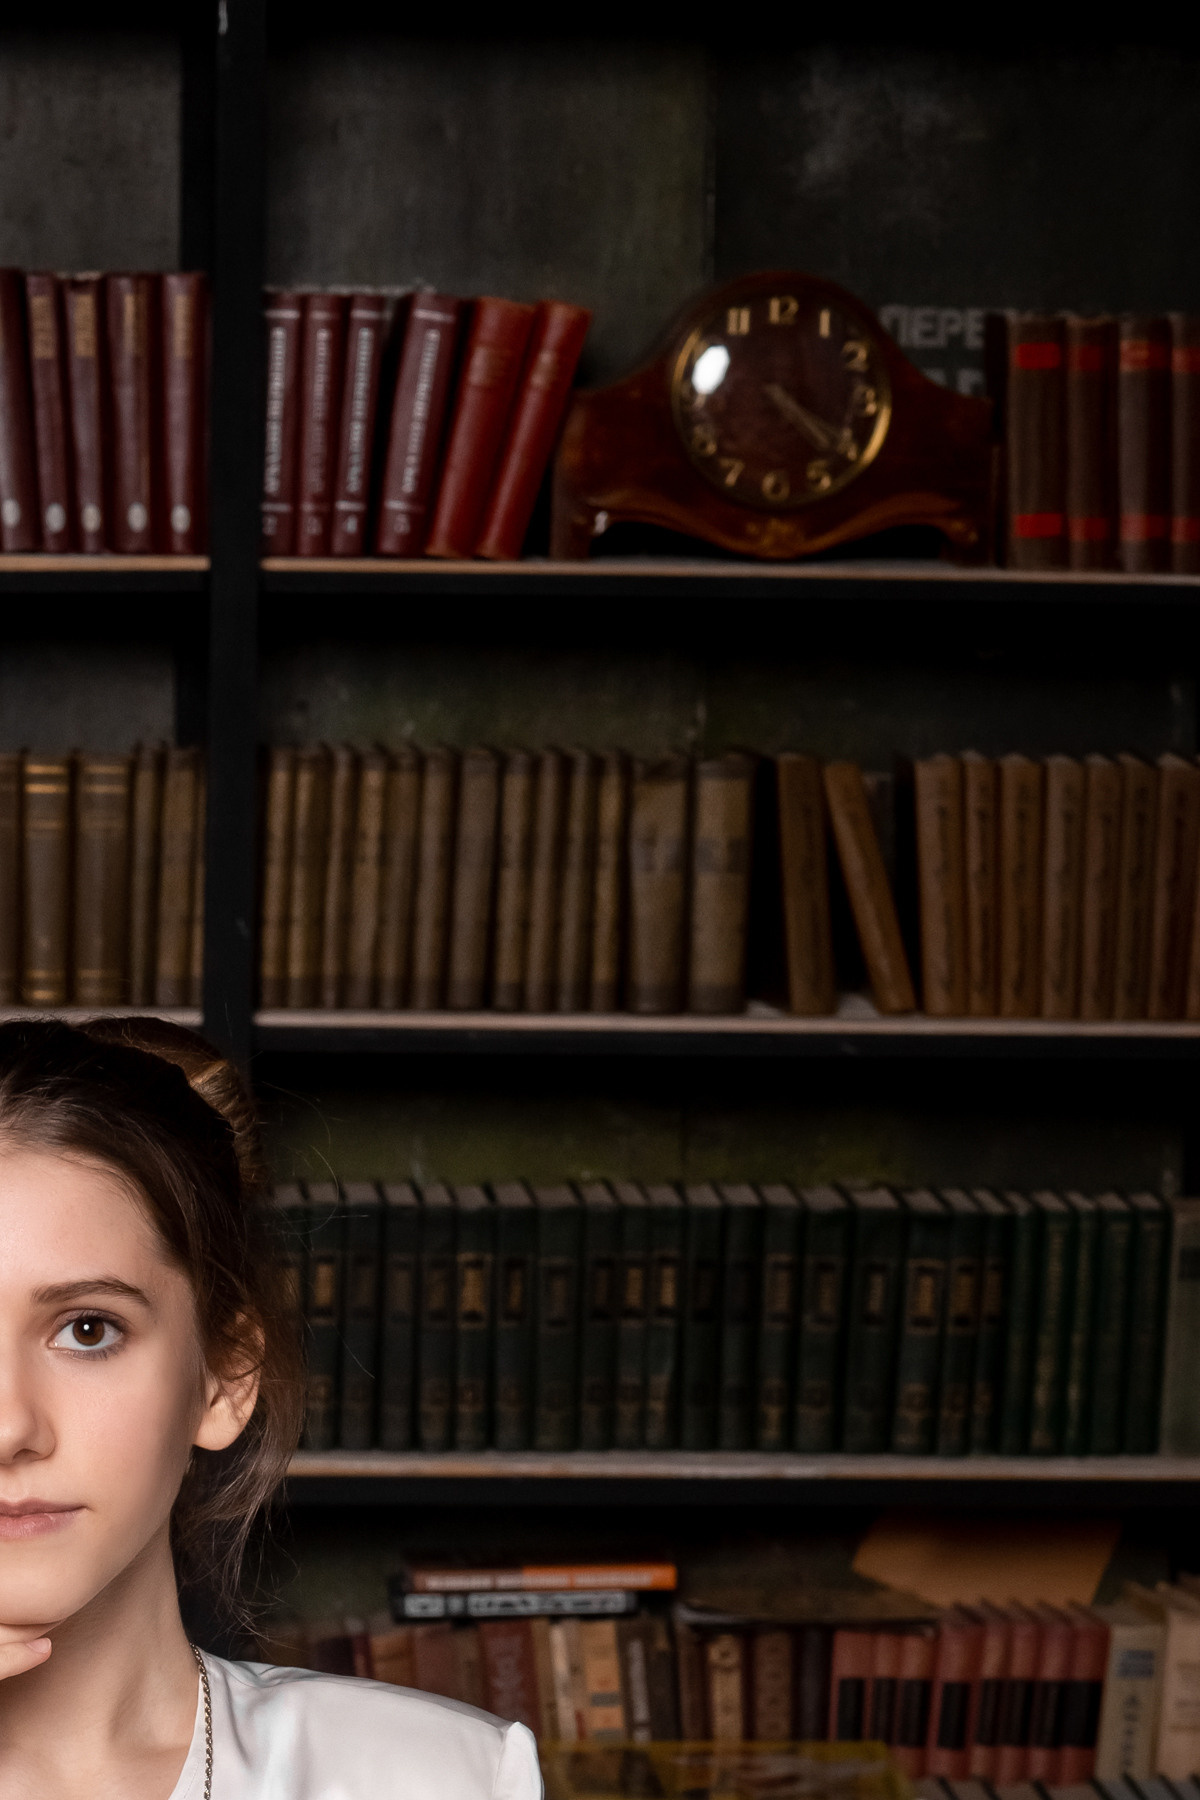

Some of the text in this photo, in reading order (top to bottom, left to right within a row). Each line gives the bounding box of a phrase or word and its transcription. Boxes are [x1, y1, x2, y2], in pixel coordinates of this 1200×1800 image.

[727, 307, 750, 336] 11
[769, 296, 799, 325] 12
[819, 309, 831, 338] 1
[878, 304, 987, 350] ПЕРЕ
[842, 340, 869, 373] 2
[719, 457, 745, 487] 7
